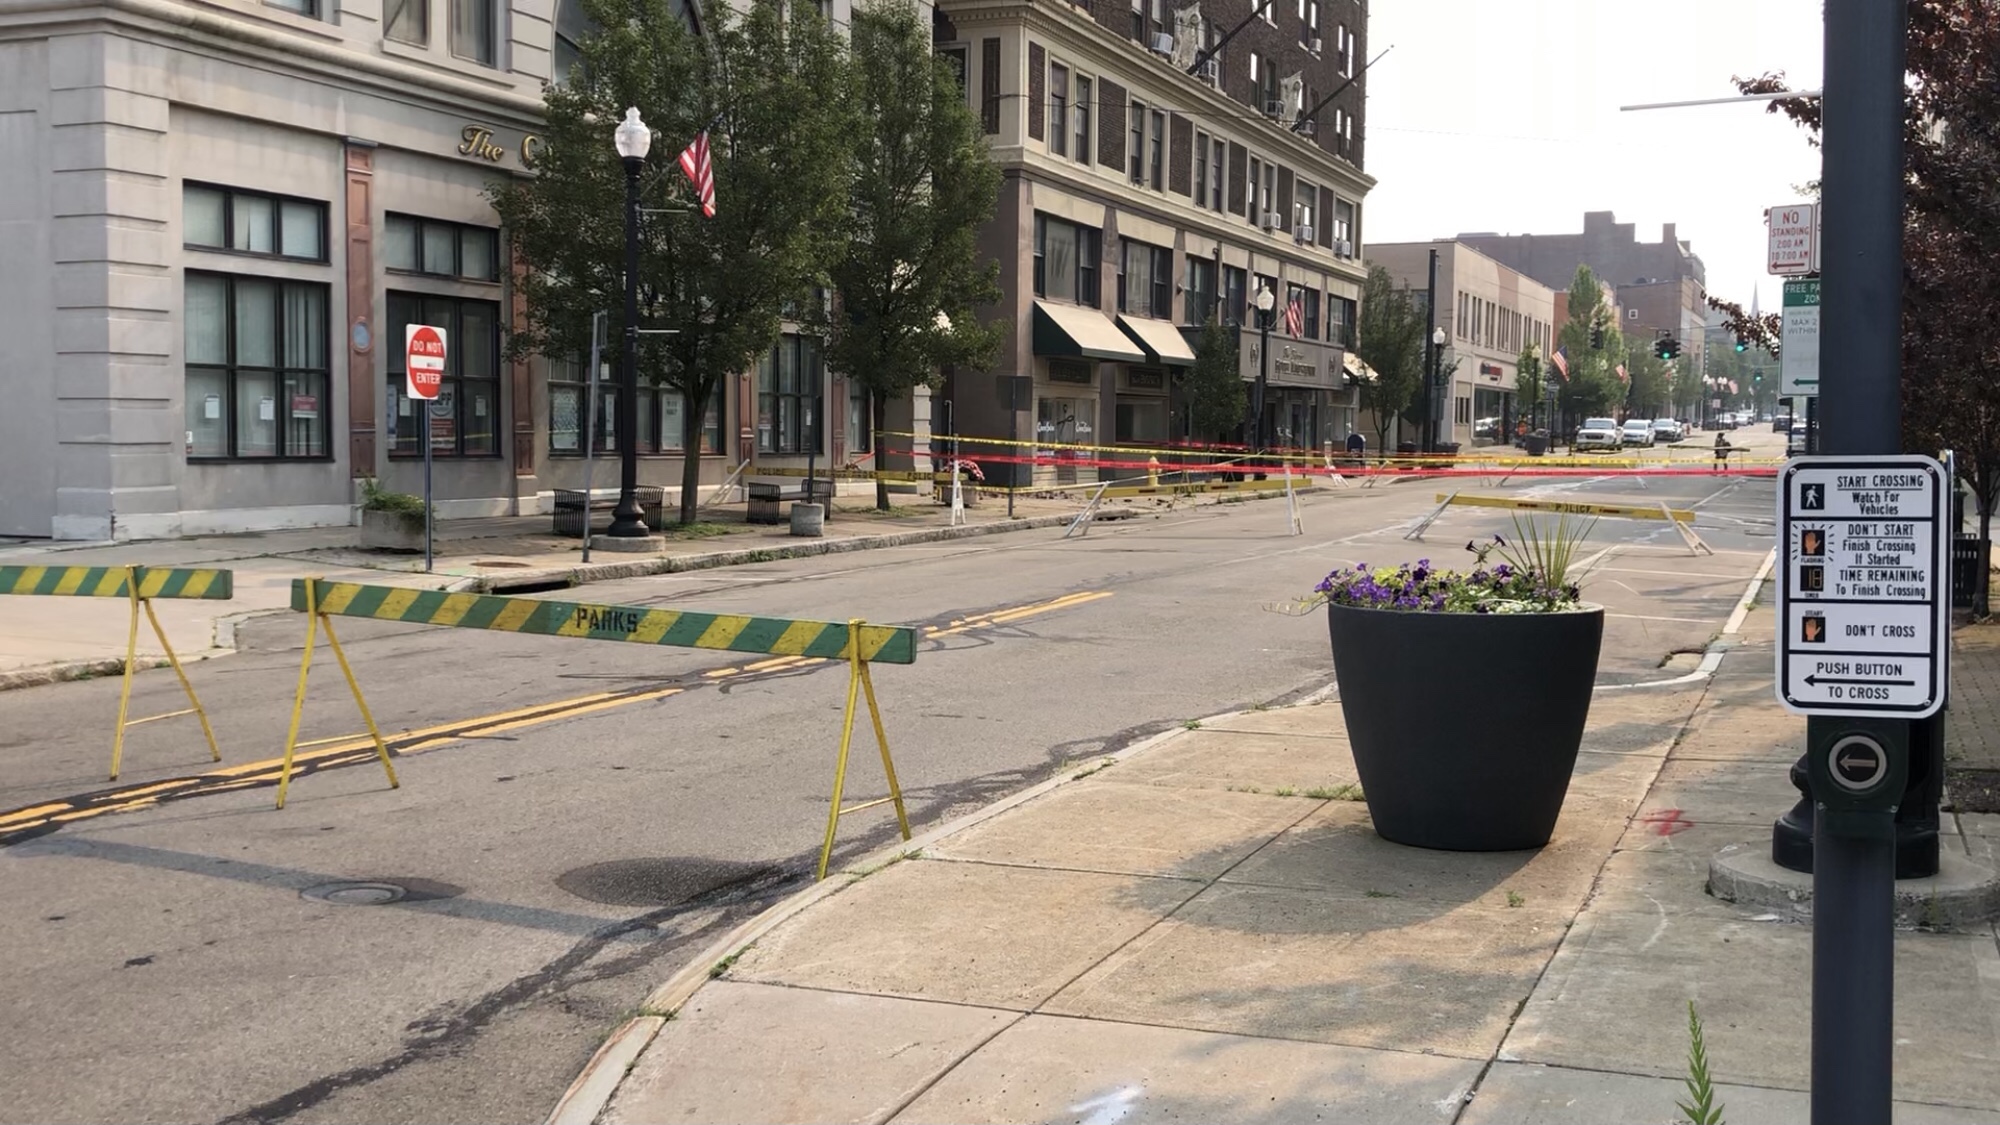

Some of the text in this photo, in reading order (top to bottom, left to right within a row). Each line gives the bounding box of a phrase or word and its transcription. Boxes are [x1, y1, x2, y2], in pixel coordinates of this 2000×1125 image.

[458, 124, 503, 161] The
[1782, 211, 1799, 224] NO
[1771, 226, 1809, 237] STANDING
[1794, 239, 1804, 247] AM
[1771, 251, 1780, 261] TO
[1799, 250, 1809, 259] AM
[1785, 283, 1807, 294] FREE
[413, 340, 442, 353] DO NOT
[416, 373, 441, 384] ENTER
[1837, 475, 1924, 488] START CROSSING
[1173, 484, 1206, 494] POLICE
[1852, 491, 1900, 503] Watch For
[1859, 504, 1899, 515] Vehicles
[1848, 524, 1914, 536] DON'T START
[1842, 540, 1916, 555] Finish Crossing
[1855, 553, 1900, 565] If Started
[1839, 570, 1925, 582] TIME REMAINING
[1835, 583, 1926, 600] To Finish Crossing
[576, 607, 638, 633] PARKS
[1846, 624, 1915, 638] DON'T CROSS
[1816, 662, 1902, 676] PUSH BUTTON
[1828, 686, 1890, 699] TO CROSS
